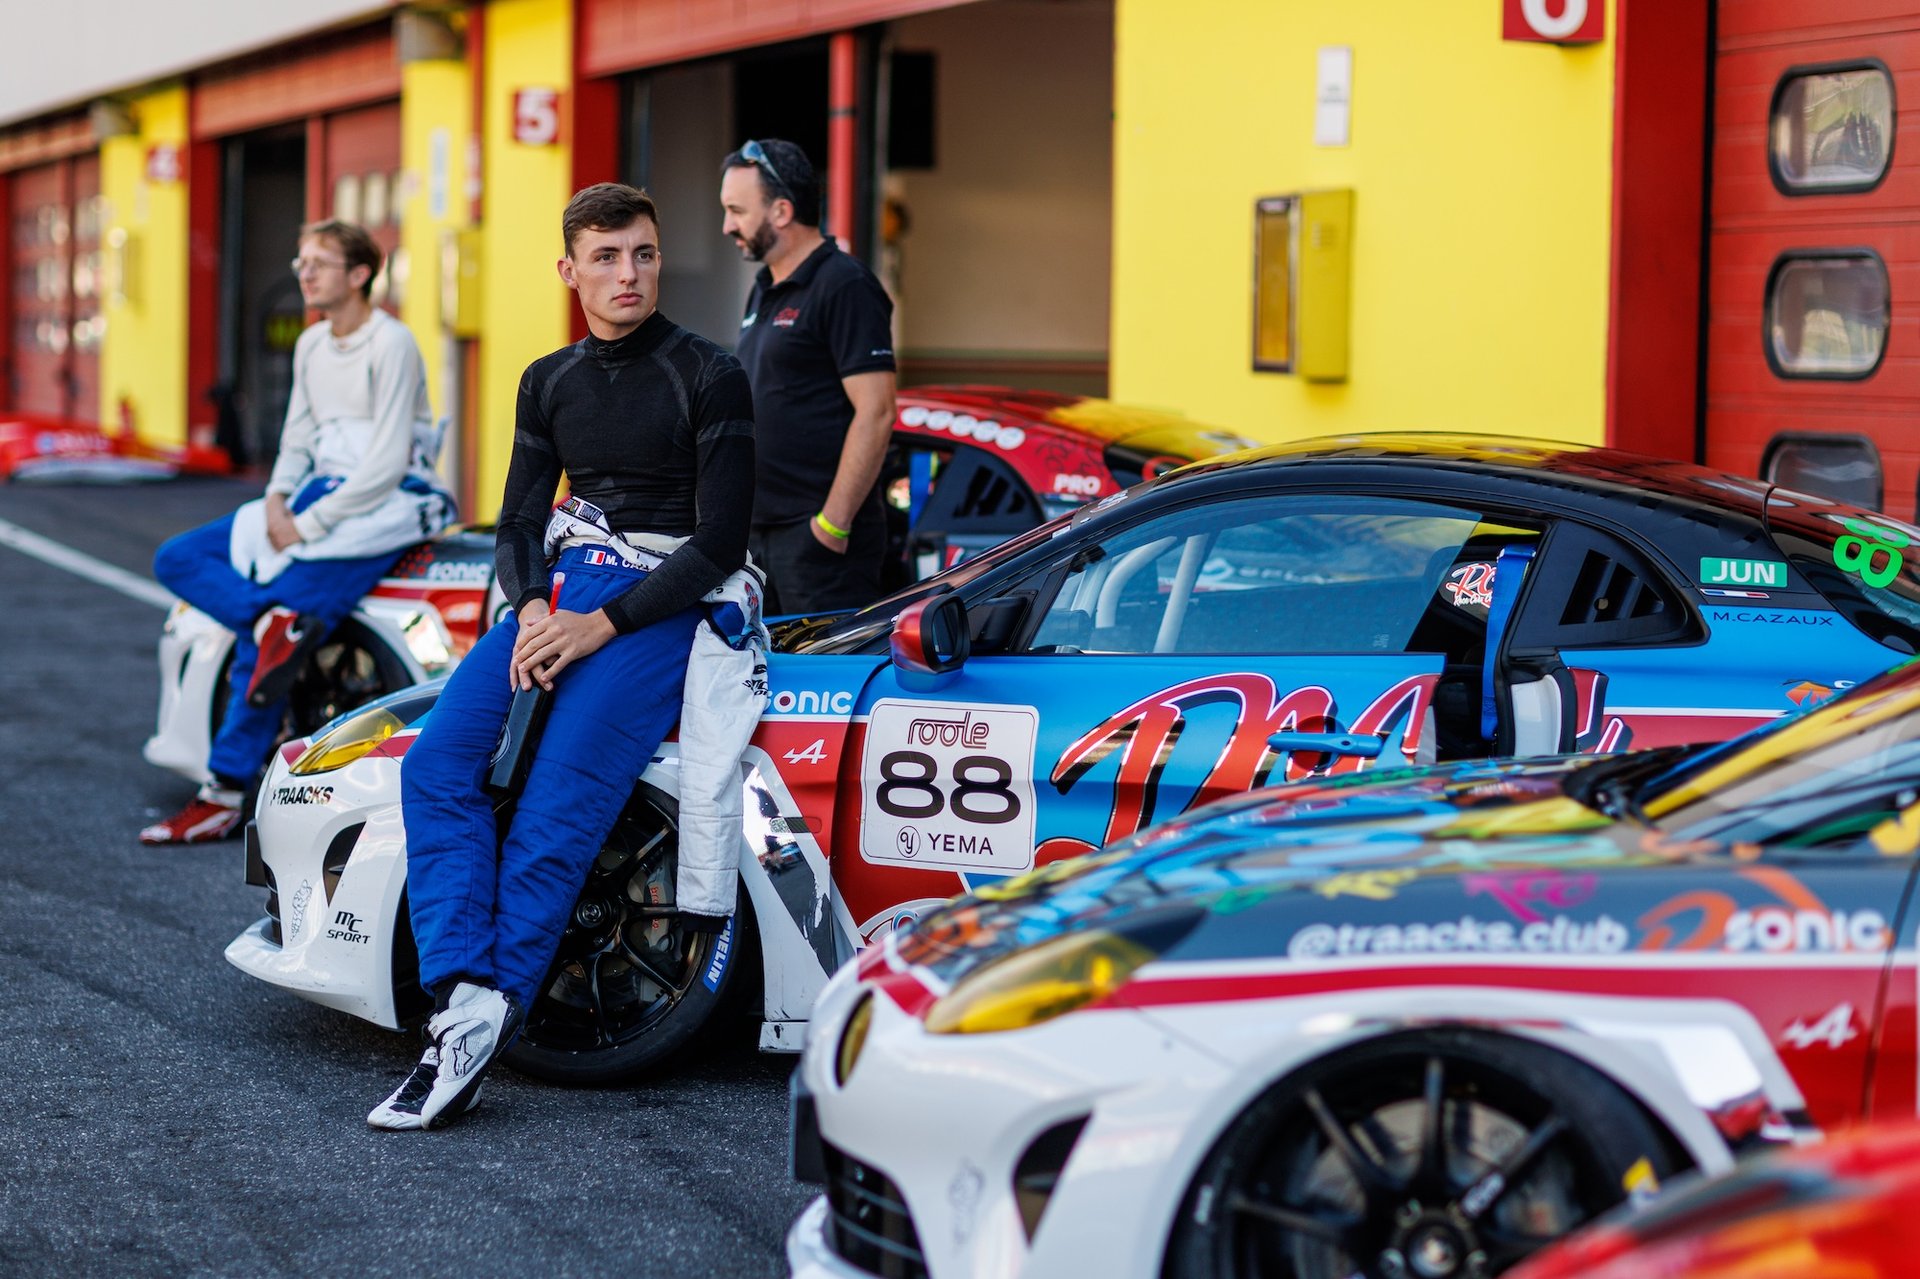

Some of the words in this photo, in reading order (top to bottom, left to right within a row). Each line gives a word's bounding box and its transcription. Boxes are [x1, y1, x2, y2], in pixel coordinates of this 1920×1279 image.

[517, 87, 556, 145] 5
[1053, 473, 1101, 496] PRO
[1712, 560, 1775, 585] JUN
[1713, 611, 1833, 627] M.CAZAUX
[876, 750, 1021, 824] 88
[927, 832, 994, 856] YEMA
[335, 911, 363, 933] MC
[326, 928, 371, 945] SPORT
[1287, 914, 1628, 959] @traacks.club
